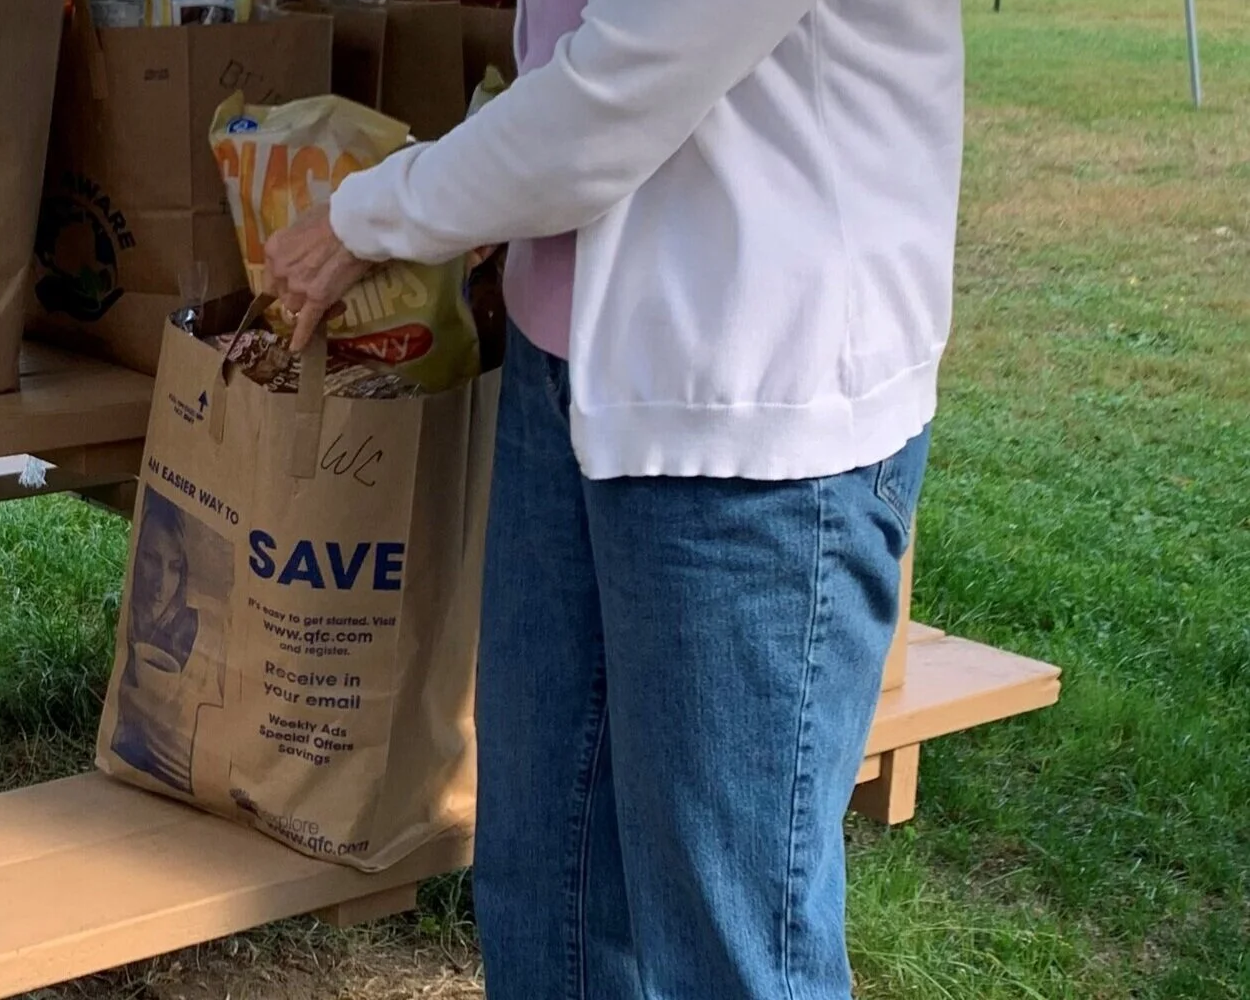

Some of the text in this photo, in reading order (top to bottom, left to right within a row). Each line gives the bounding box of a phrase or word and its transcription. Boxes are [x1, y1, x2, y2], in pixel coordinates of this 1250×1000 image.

[327, 264, 428, 331] HIPS
[162, 466, 196, 499] EASIER
[199, 490, 224, 515] WAY
[225, 506, 240, 525] TO
[248, 529, 406, 591] SAVE
[262, 606, 286, 621] easy
[289, 613, 300, 624] to
[303, 616, 324, 628] get
[326, 616, 369, 626] started.
[372, 616, 396, 626] Visit
[263, 619, 373, 644] www.qfc.com
[279, 641, 351, 657] and register.
[265, 660, 361, 688] Receive in
[263, 681, 361, 709] your email
[259, 725, 354, 751] Special Offers
[268, 712, 348, 738] Weekly Ads
